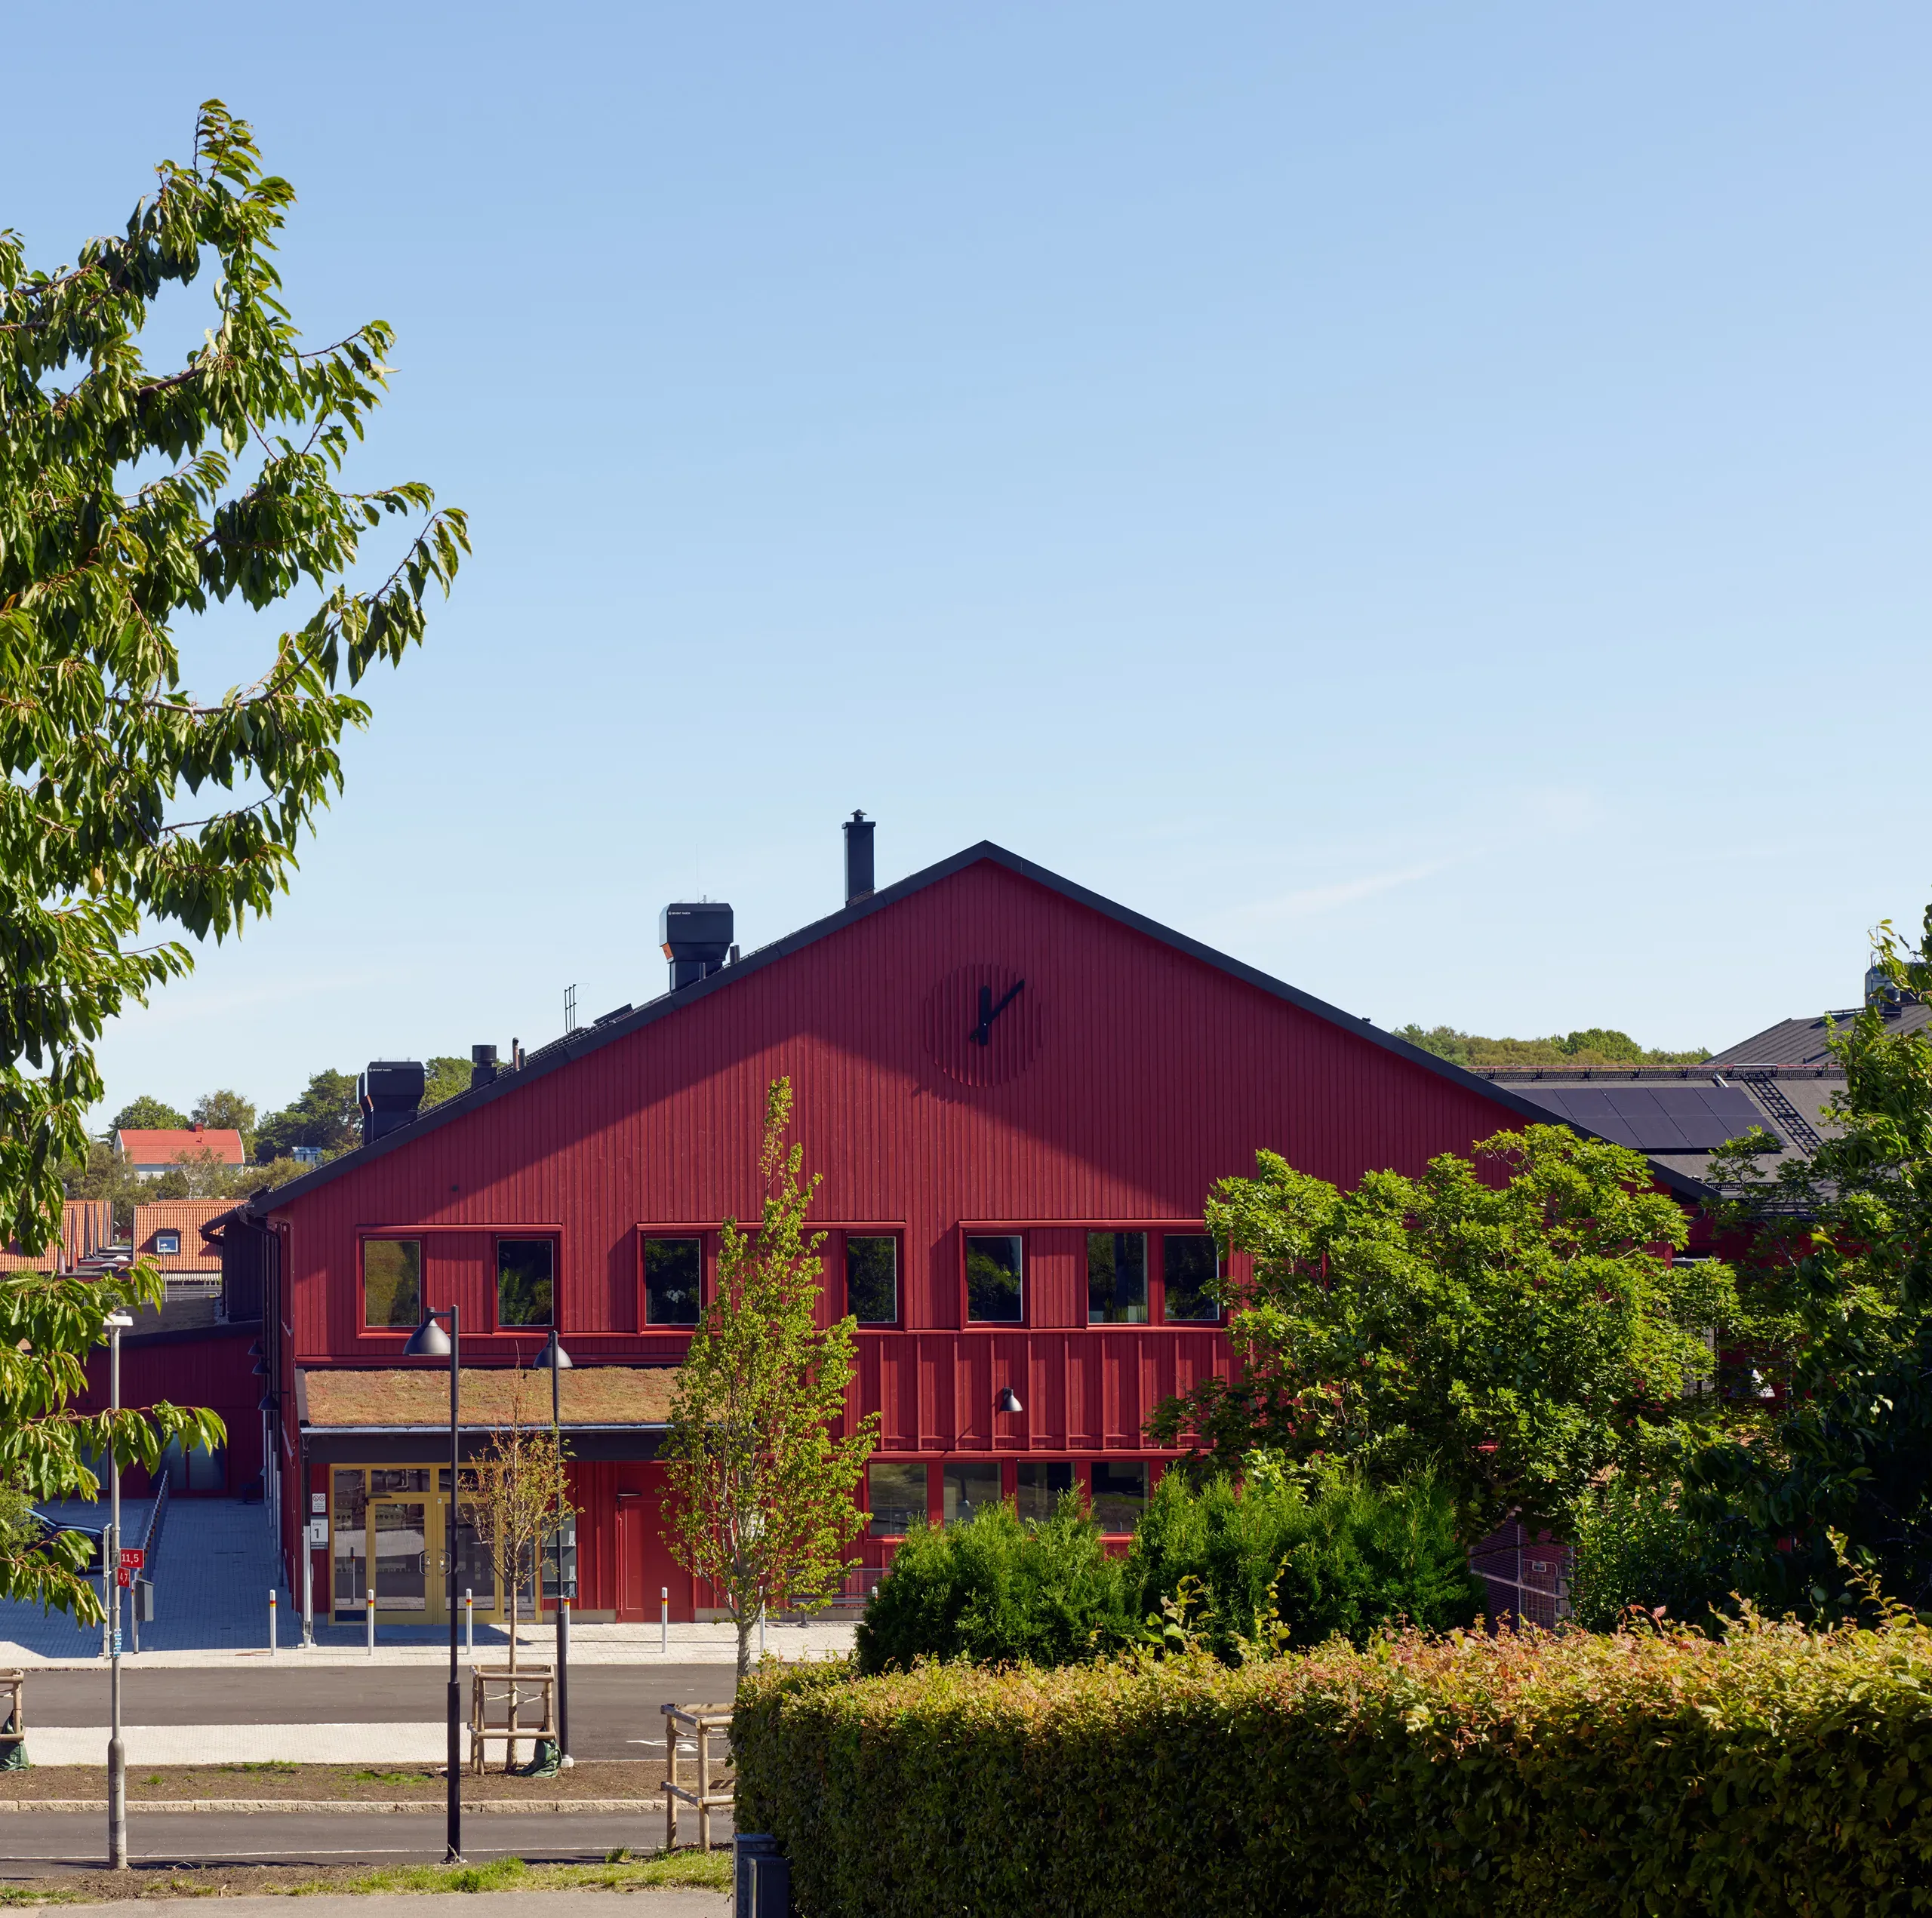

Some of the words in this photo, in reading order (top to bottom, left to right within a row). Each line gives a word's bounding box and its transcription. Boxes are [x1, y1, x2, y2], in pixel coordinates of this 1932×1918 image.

[314, 1528, 319, 1538] 1
[122, 1553, 139, 1565] 11,5
[119, 1572, 128, 1584] 4,7
